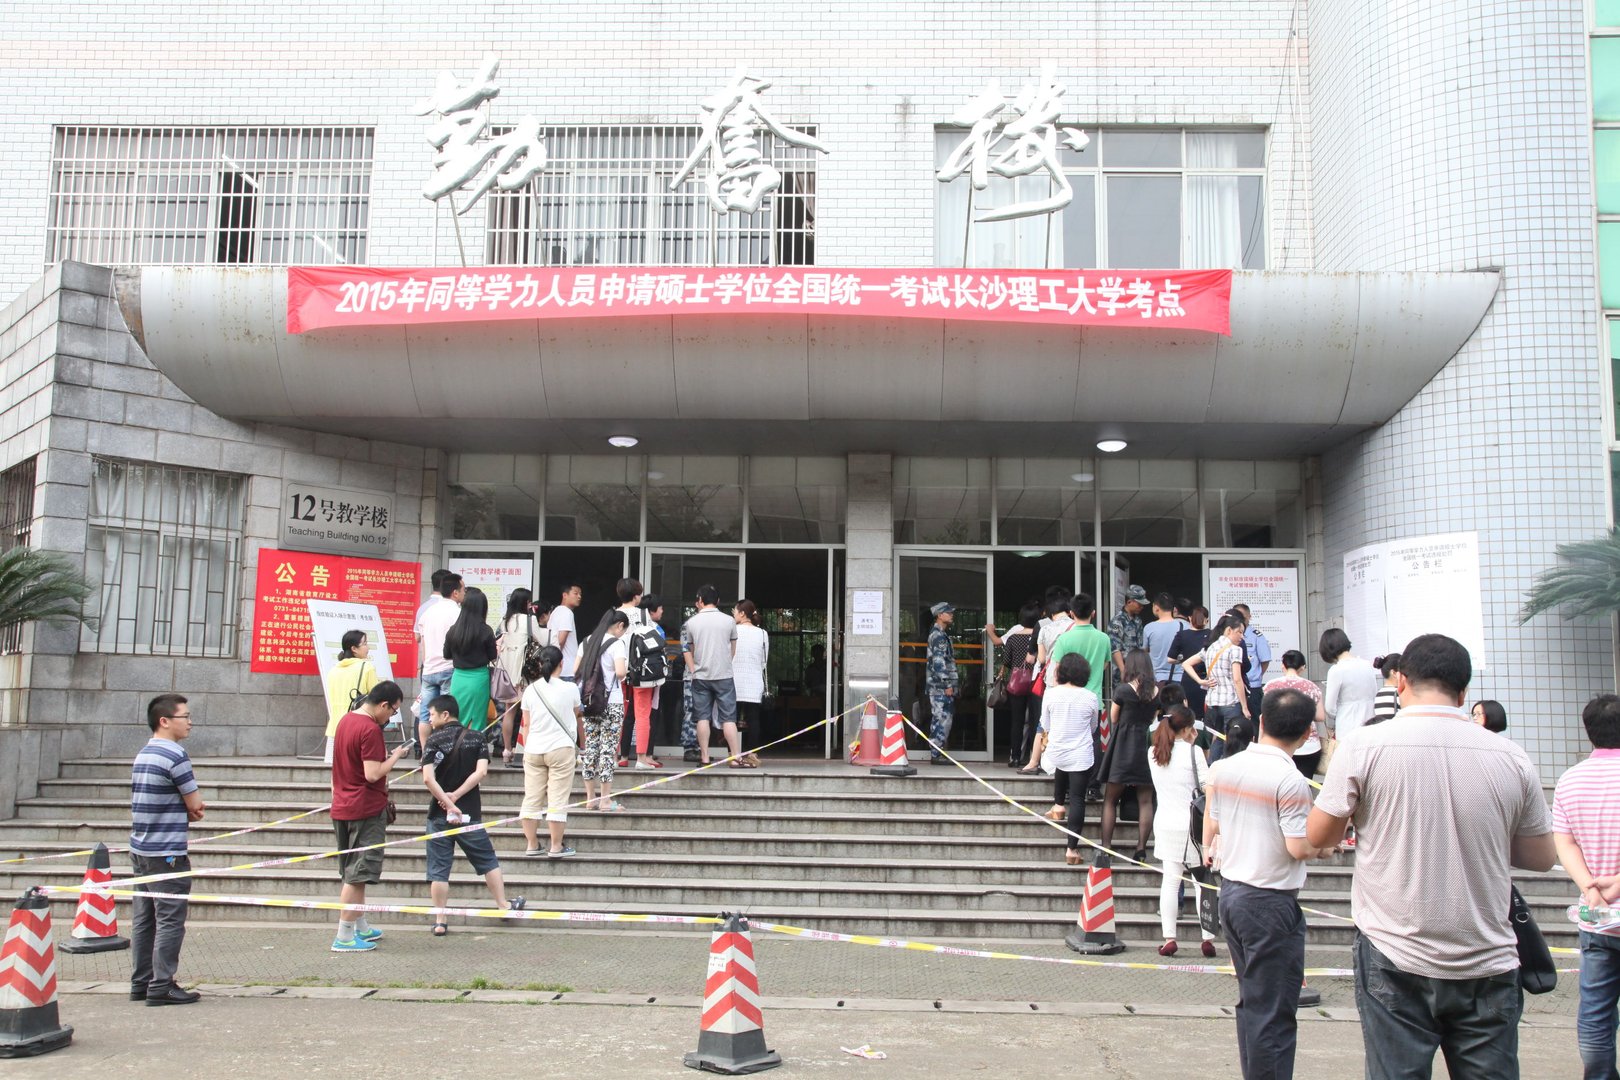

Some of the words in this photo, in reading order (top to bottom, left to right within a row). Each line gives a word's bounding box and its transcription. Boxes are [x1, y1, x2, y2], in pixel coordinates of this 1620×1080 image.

[335, 272, 1186, 319] 2015年同等学力人员申请硕士学位全国统一考试长沙理工大学考点
[290, 493, 389, 529] 12号教学楼
[287, 525, 325, 540] Teaching
[326, 530, 360, 543] Building
[361, 533, 387, 545] NO.12
[274, 562, 331, 587] 公告
[459, 567, 522, 576] 十二号教学楼平面图
